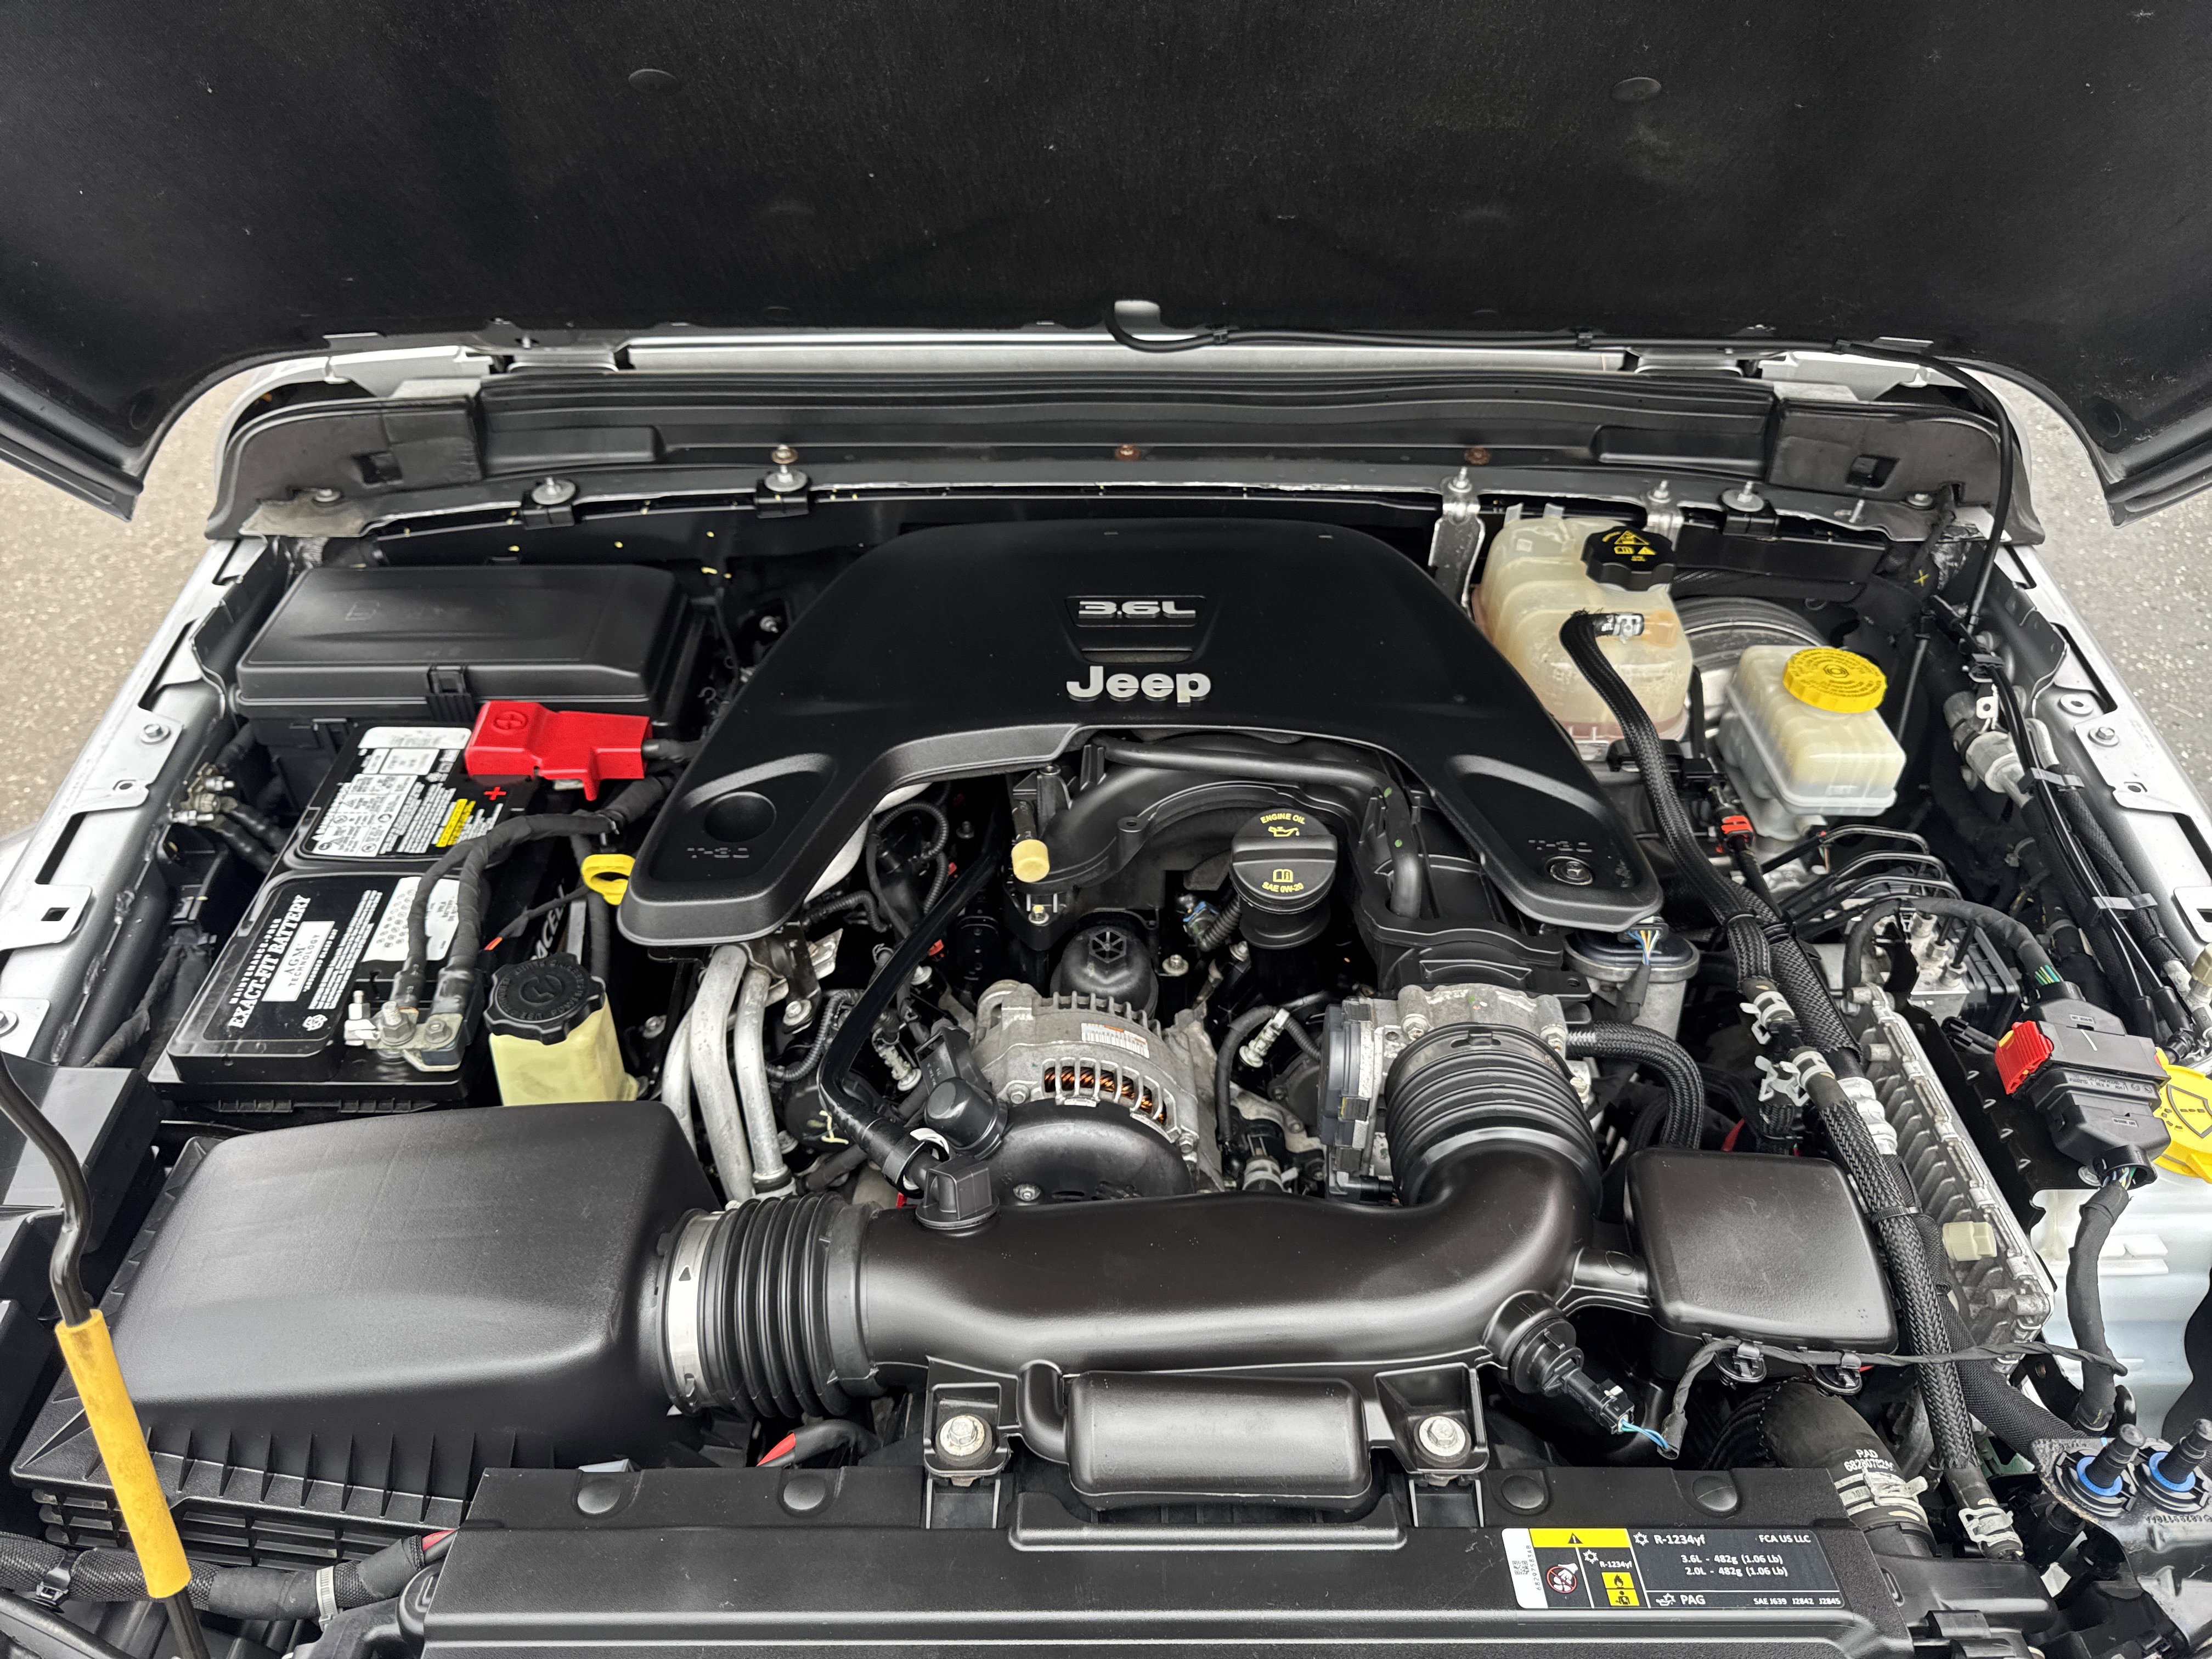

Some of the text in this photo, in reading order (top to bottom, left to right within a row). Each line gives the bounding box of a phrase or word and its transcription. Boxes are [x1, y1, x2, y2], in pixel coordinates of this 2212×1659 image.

[1079, 601, 1196, 618] 3.6L
[1066, 665, 1211, 707] Jeep
[1260, 813, 1306, 824] ENGINE OIL
[1262, 882, 1304, 893] SAE 0W-20
[228, 894, 311, 1029] EXACT-FIT BATTERY
[288, 934, 321, 987] TECHNOLOGY
[1855, 1449, 1878, 1458] PAD
[1654, 1534, 1706, 1547] R-1234yf
[1758, 1534, 1811, 1543] FCA US LLC
[1599, 1561, 1632, 1569] R-1234yf
[1681, 1555, 1702, 1564] 3.6L
[1714, 1555, 1739, 1565] 482g
[1741, 1555, 1765, 1564] (1.06
[1767, 1555, 1783, 1565] Lb)
[1685, 1567, 1707, 1576] 2.0L
[1718, 1567, 1743, 1577] 482g
[1746, 1567, 1770, 1577] (1.06
[1771, 1567, 1788, 1577] Lb)
[1680, 1595, 1706, 1605] PAG
